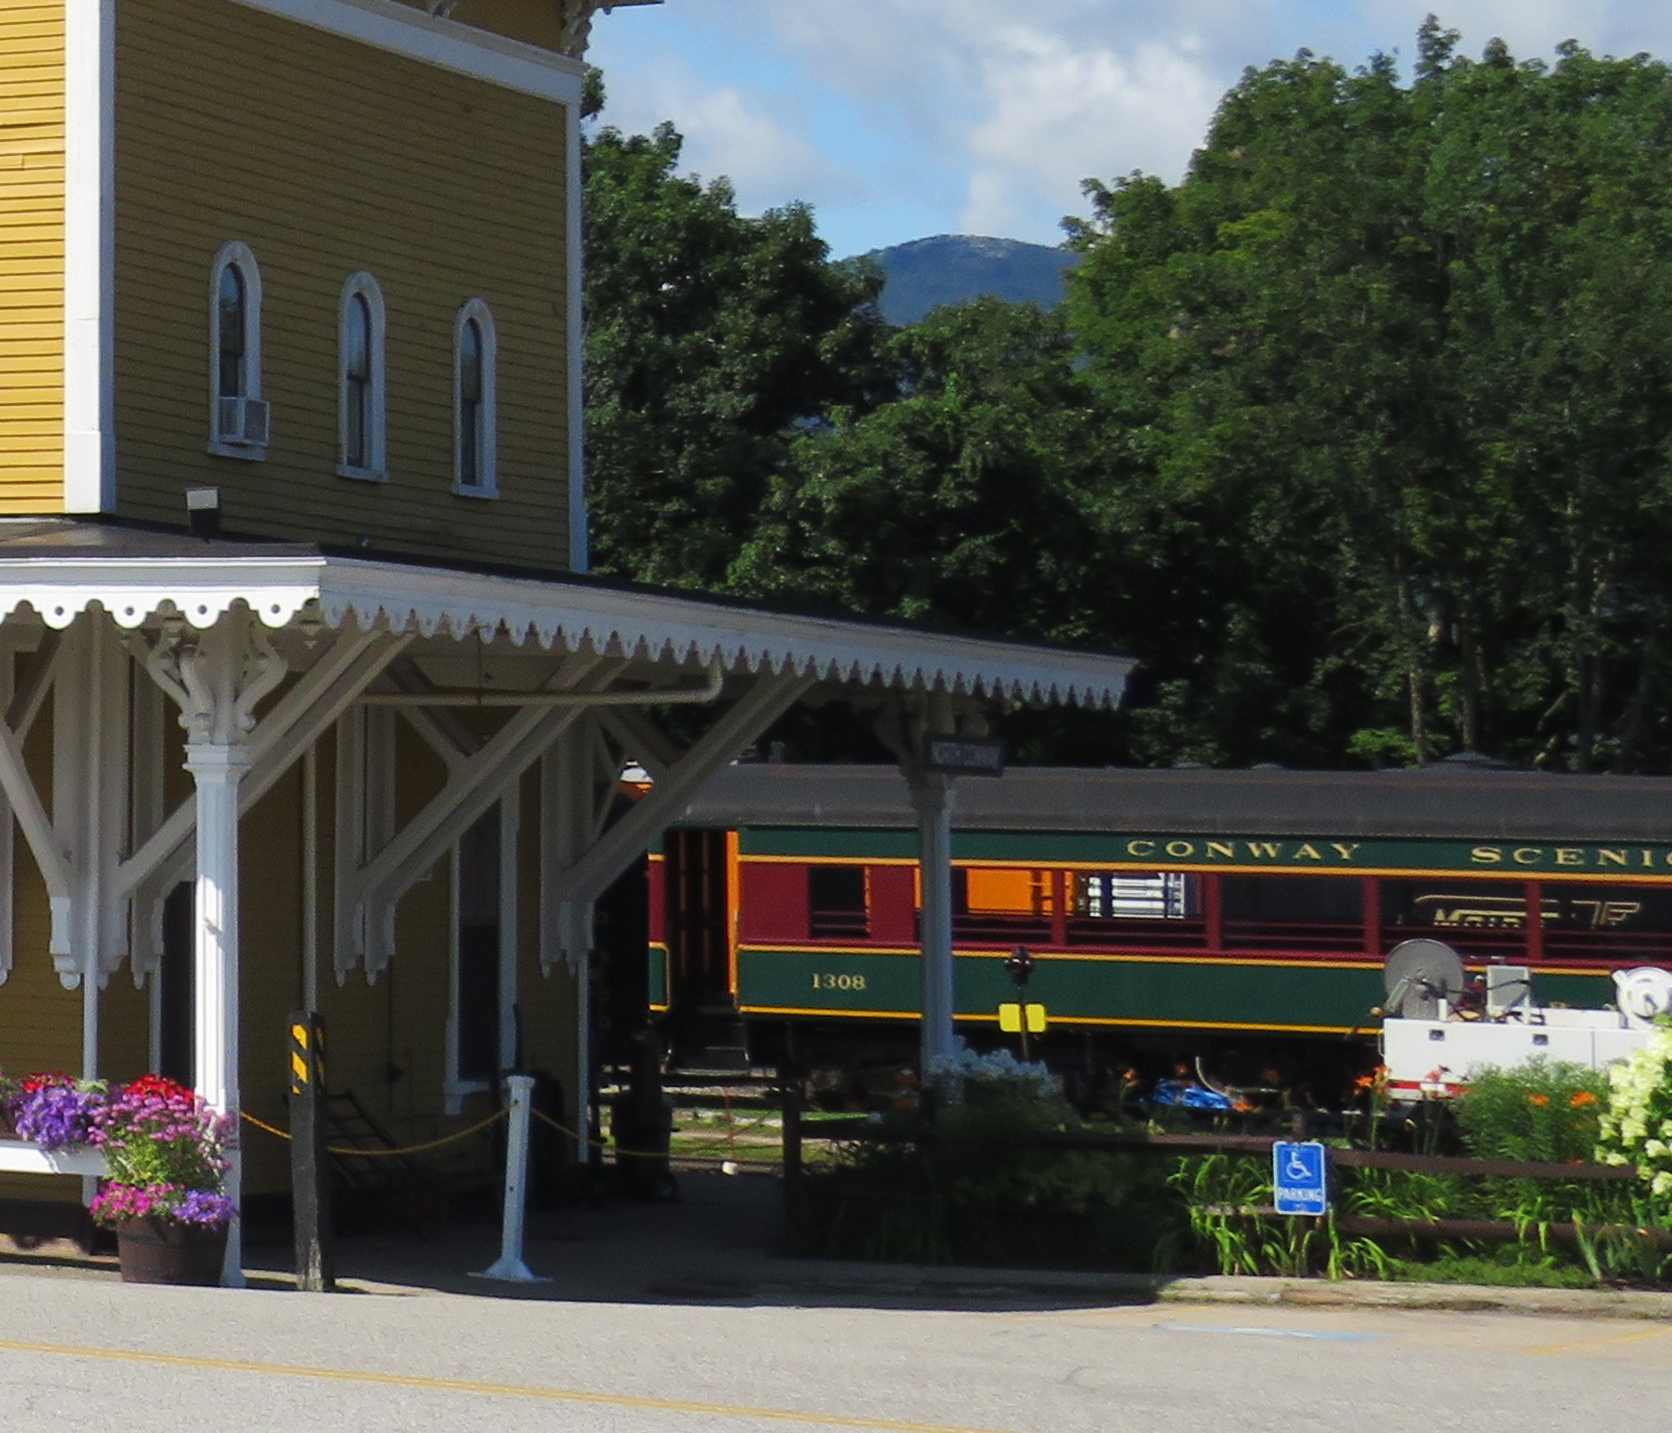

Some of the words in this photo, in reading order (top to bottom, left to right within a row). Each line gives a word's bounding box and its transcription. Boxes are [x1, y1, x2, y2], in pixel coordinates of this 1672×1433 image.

[1126, 840, 1361, 860] CONWAY
[1471, 846, 1672, 868] SCENI
[812, 973, 866, 990] 1308
